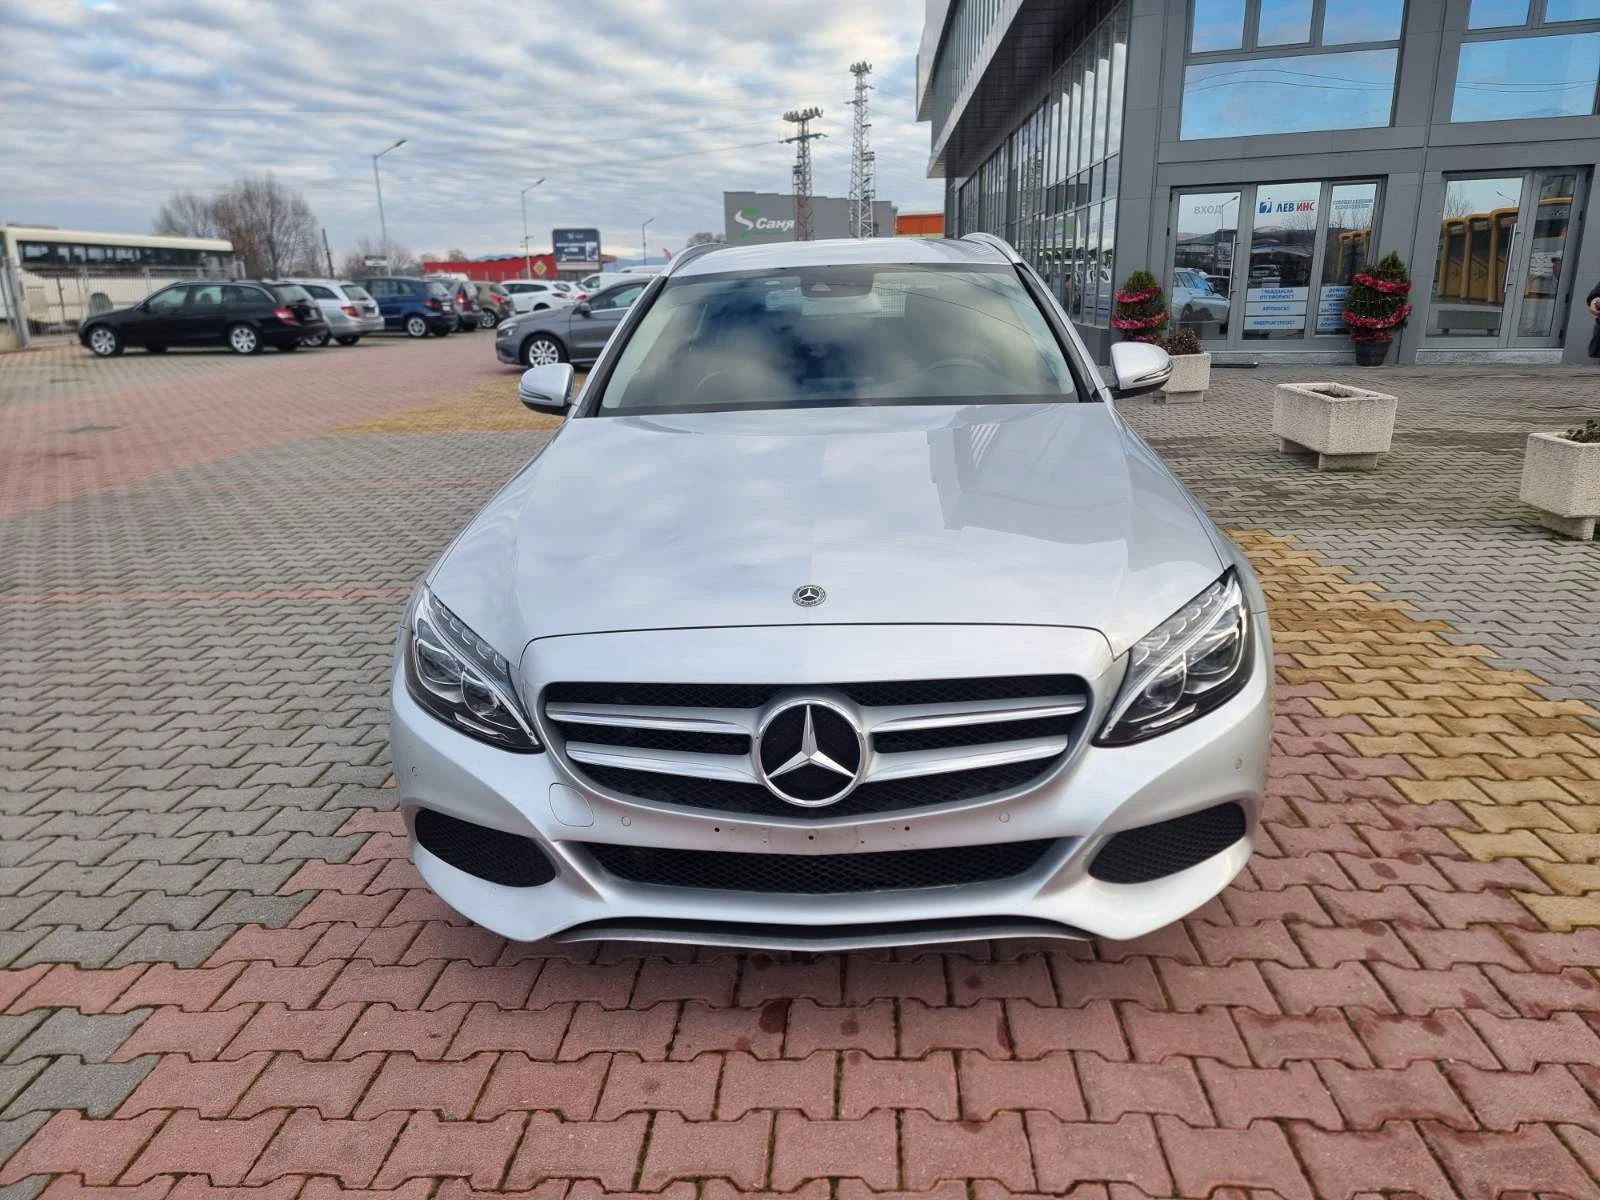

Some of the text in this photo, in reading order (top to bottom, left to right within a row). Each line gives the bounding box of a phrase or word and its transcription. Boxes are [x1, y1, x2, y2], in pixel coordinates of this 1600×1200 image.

[1194, 205, 1222, 216] ВХОД
[1276, 202, 1316, 213] ЛЕВ ИНС
[756, 217, 795, 232] Саня
